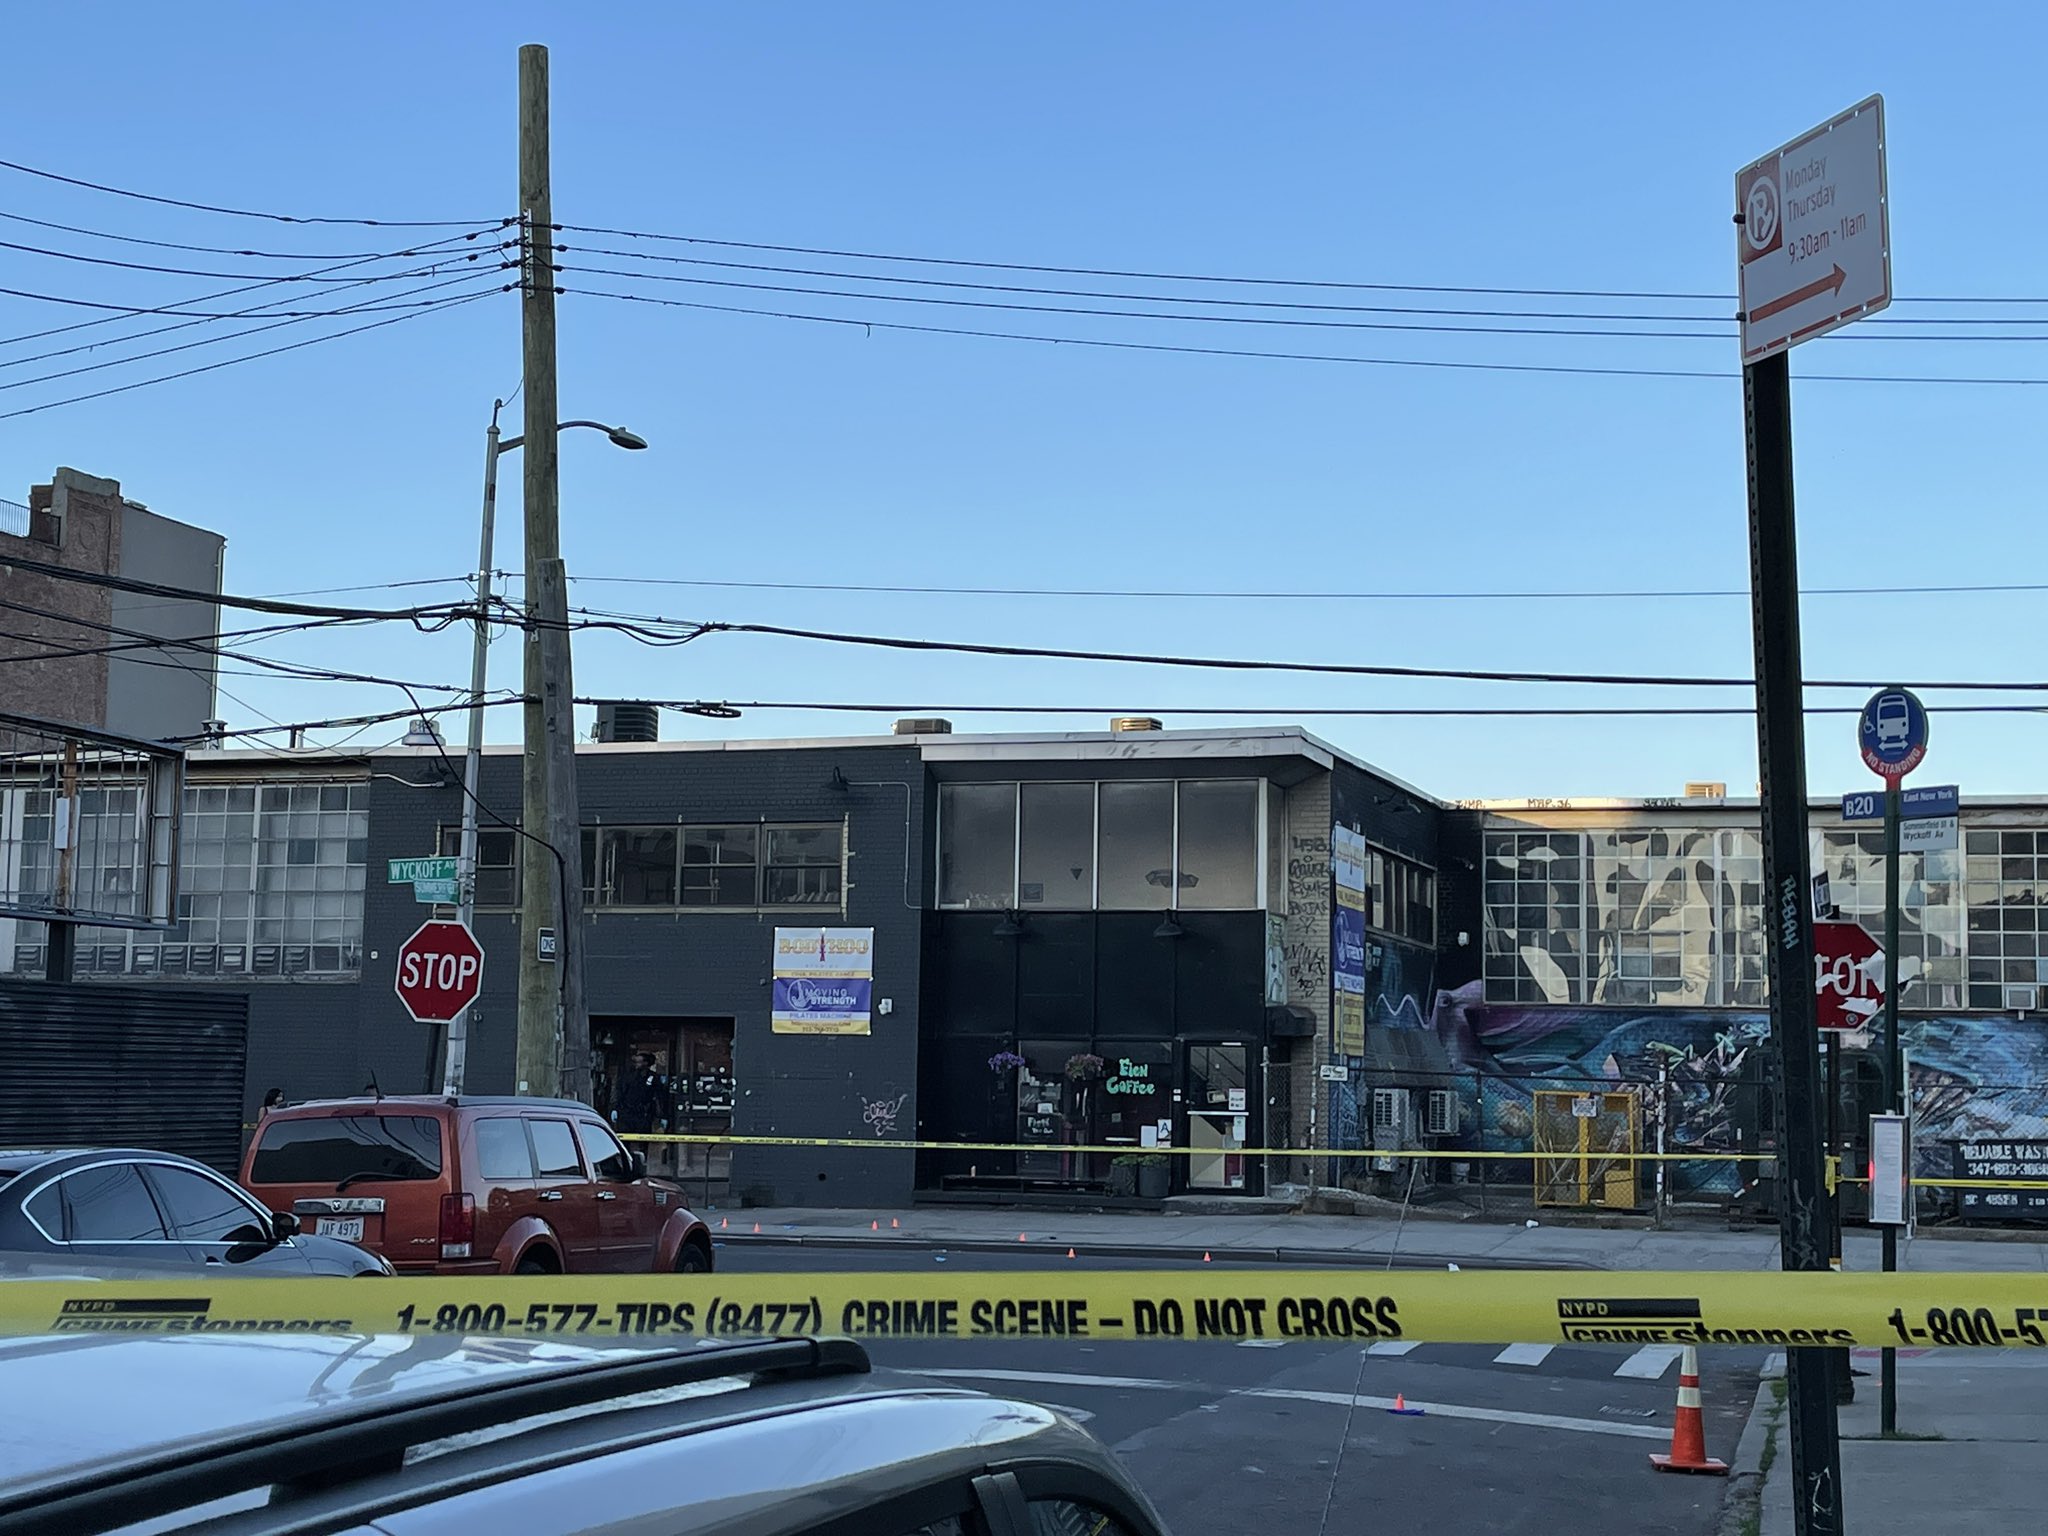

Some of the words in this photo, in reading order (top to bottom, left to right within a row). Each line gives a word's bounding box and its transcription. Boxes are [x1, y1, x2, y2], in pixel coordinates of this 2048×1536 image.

[1785, 156, 1827, 193] Monday
[1787, 183, 1835, 222] Thursday
[1789, 231, 1830, 265] 9:30am
[1841, 213, 1866, 240] 11am
[1865, 751, 1877, 768] NO
[1878, 748, 1921, 774] STANDING
[1903, 793, 1919, 802] East
[1920, 792, 1936, 800] New
[1938, 789, 1953, 799] York
[1845, 796, 1874, 816] B20
[390, 861, 442, 880] WYCKOFF
[402, 952, 477, 991] STOP
[805, 988, 848, 997] MOVING
[811, 996, 857, 1005] STRENGTH
[319, 1222, 335, 1236] JAF
[337, 1222, 360, 1236] 4973
[67, 1302, 116, 1312] NYPD
[397, 1303, 695, 1334] 1-800-577-TIPS
[705, 1297, 822, 1335] (8477)
[841, 1299, 958, 1335] CRIME
[970, 1299, 1090, 1335] SCENE
[1132, 1298, 1184, 1336] DO
[1194, 1298, 1266, 1336] NOT
[1277, 1296, 1402, 1337] CROSS
[1562, 1302, 1609, 1315] NYPD
